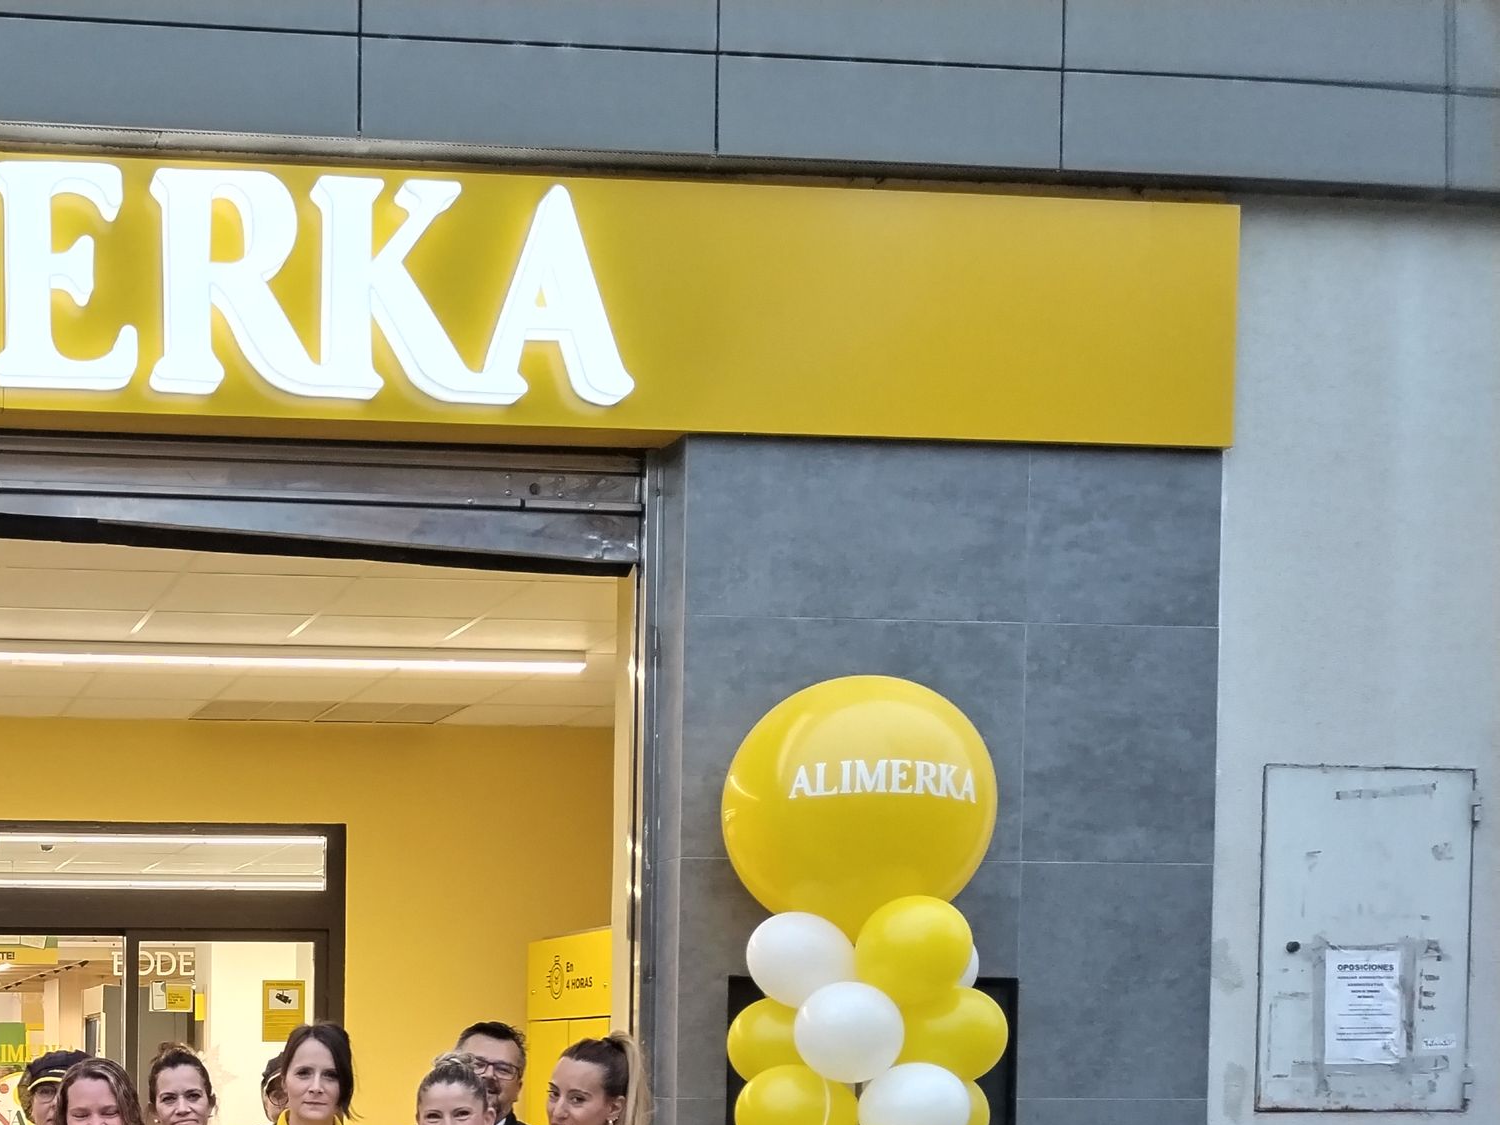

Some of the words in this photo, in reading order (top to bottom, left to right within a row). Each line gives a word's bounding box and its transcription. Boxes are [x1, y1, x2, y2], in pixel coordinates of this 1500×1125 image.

[788, 760, 977, 803] ALIMERKA
[566, 961, 573, 972] En
[566, 979, 570, 990] 4
[571, 976, 593, 989] HORAS
